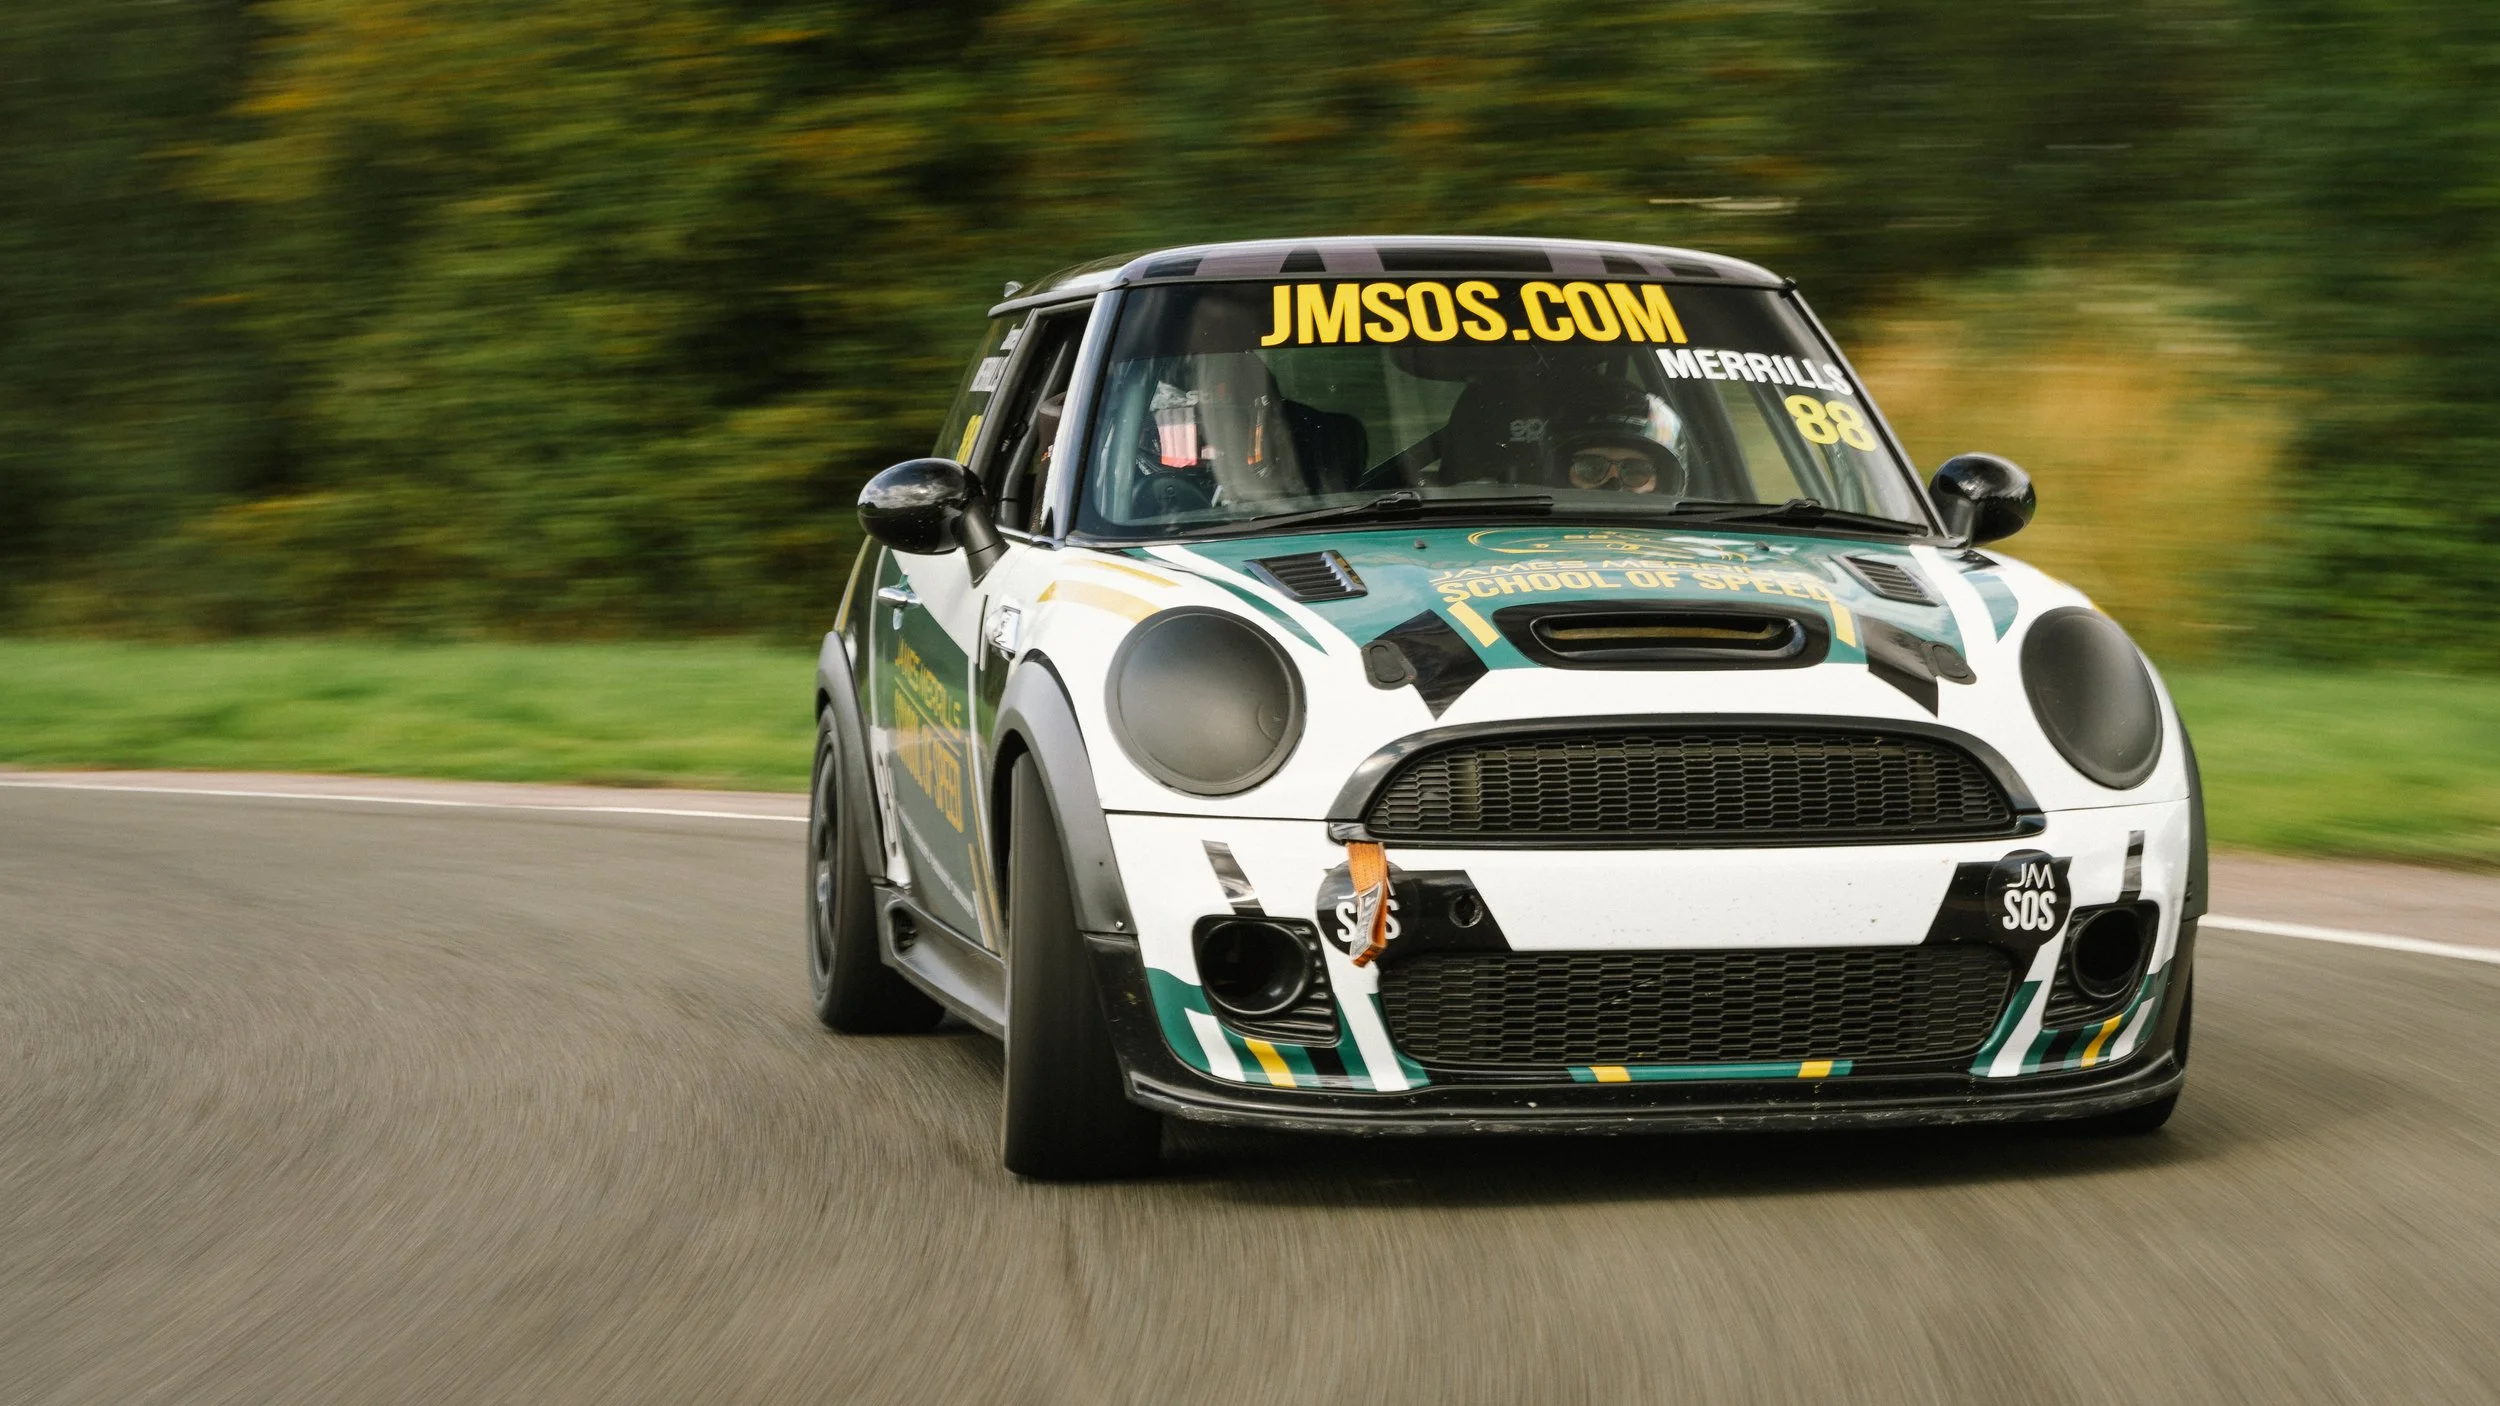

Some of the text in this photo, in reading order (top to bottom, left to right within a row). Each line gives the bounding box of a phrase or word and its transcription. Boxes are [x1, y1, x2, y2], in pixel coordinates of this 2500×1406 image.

[1261, 281, 1688, 347] JMSOS.COM
[1655, 348, 1853, 396] MERRILLS
[1784, 394, 1877, 452] 88
[1429, 560, 1588, 583] JAMES
[1437, 571, 1837, 603] SCHOOL OF SPEED
[2006, 862, 2056, 890] JM
[1335, 898, 1401, 943] SS
[2002, 889, 2058, 931] SOS
